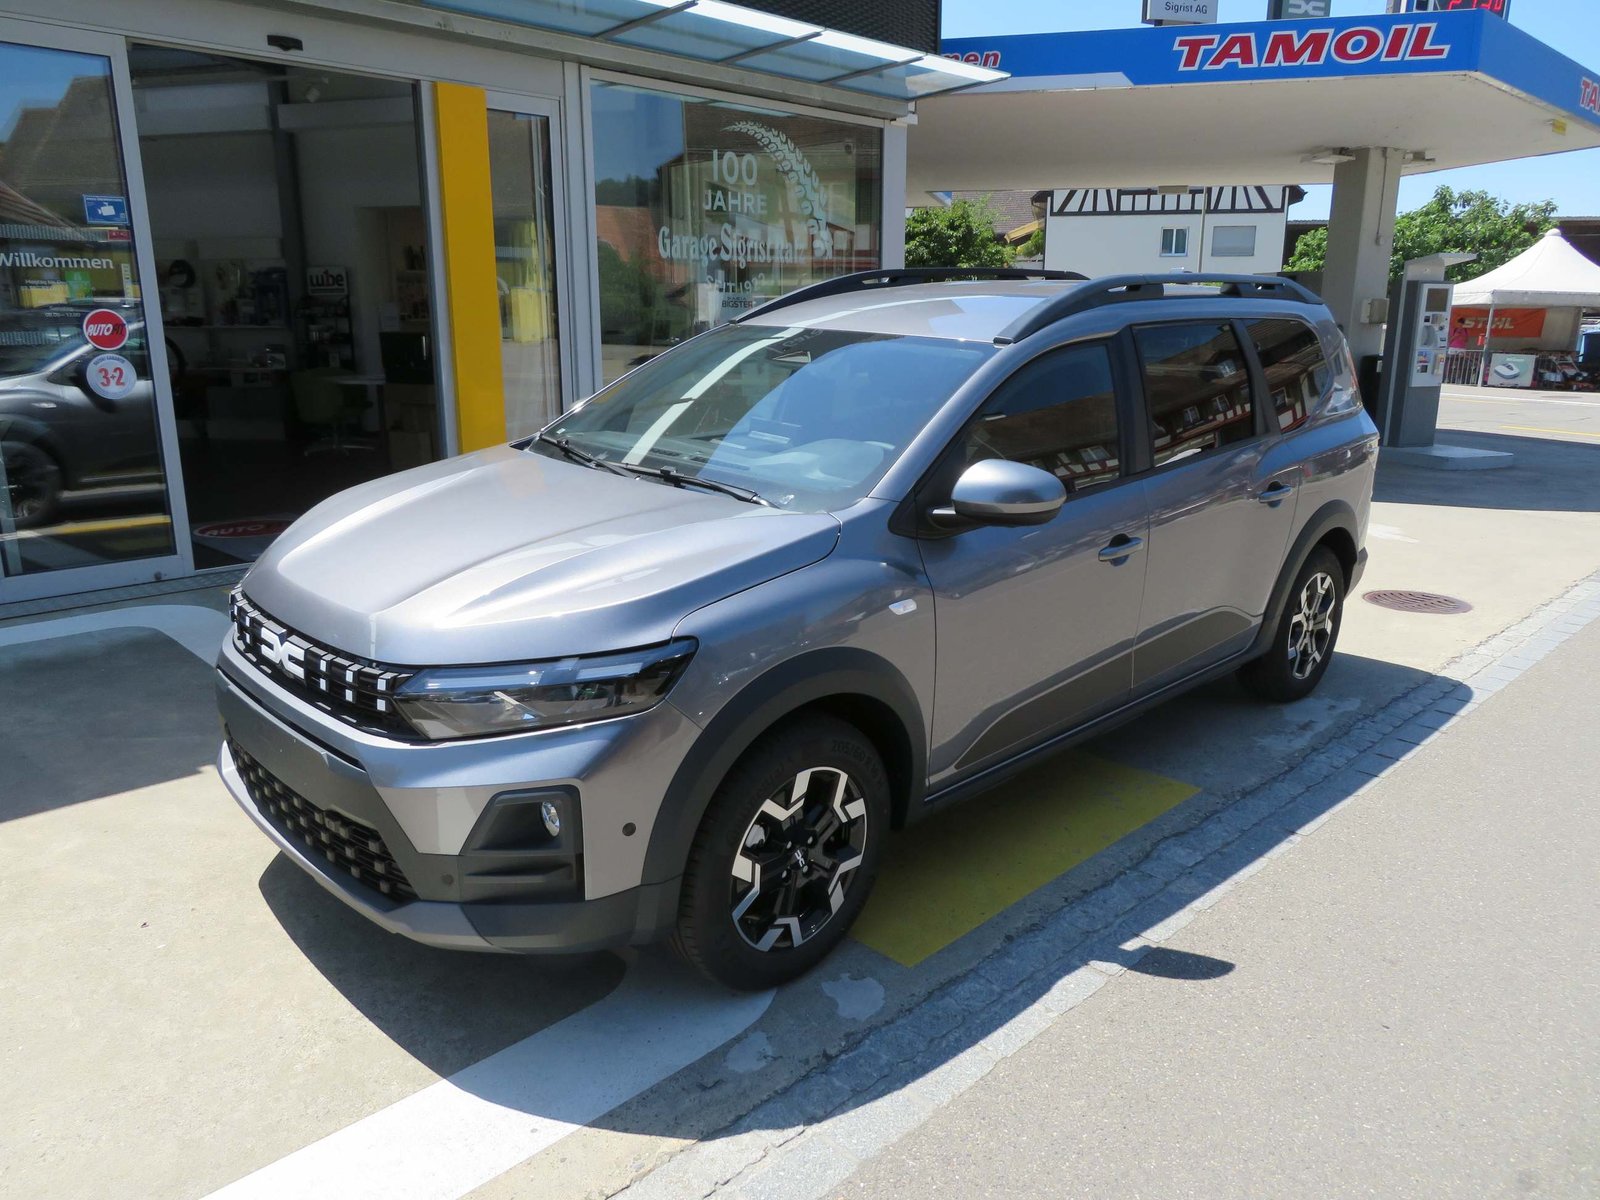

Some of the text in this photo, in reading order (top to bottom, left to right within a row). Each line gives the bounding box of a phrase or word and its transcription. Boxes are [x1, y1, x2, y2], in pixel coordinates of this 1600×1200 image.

[1164, 2, 1208, 14] Sigrist AG
[1172, 22, 1451, 72] TAMOIL
[1580, 77, 1600, 115] TA
[711, 149, 758, 186] 100
[703, 190, 767, 215] JAHRE
[658, 225, 717, 268] Garage
[720, 222, 772, 269] Sigrist
[0, 252, 115, 269] Willkommen
[722, 300, 753, 308] BIGSTER
[1462, 317, 1515, 329] STHL
